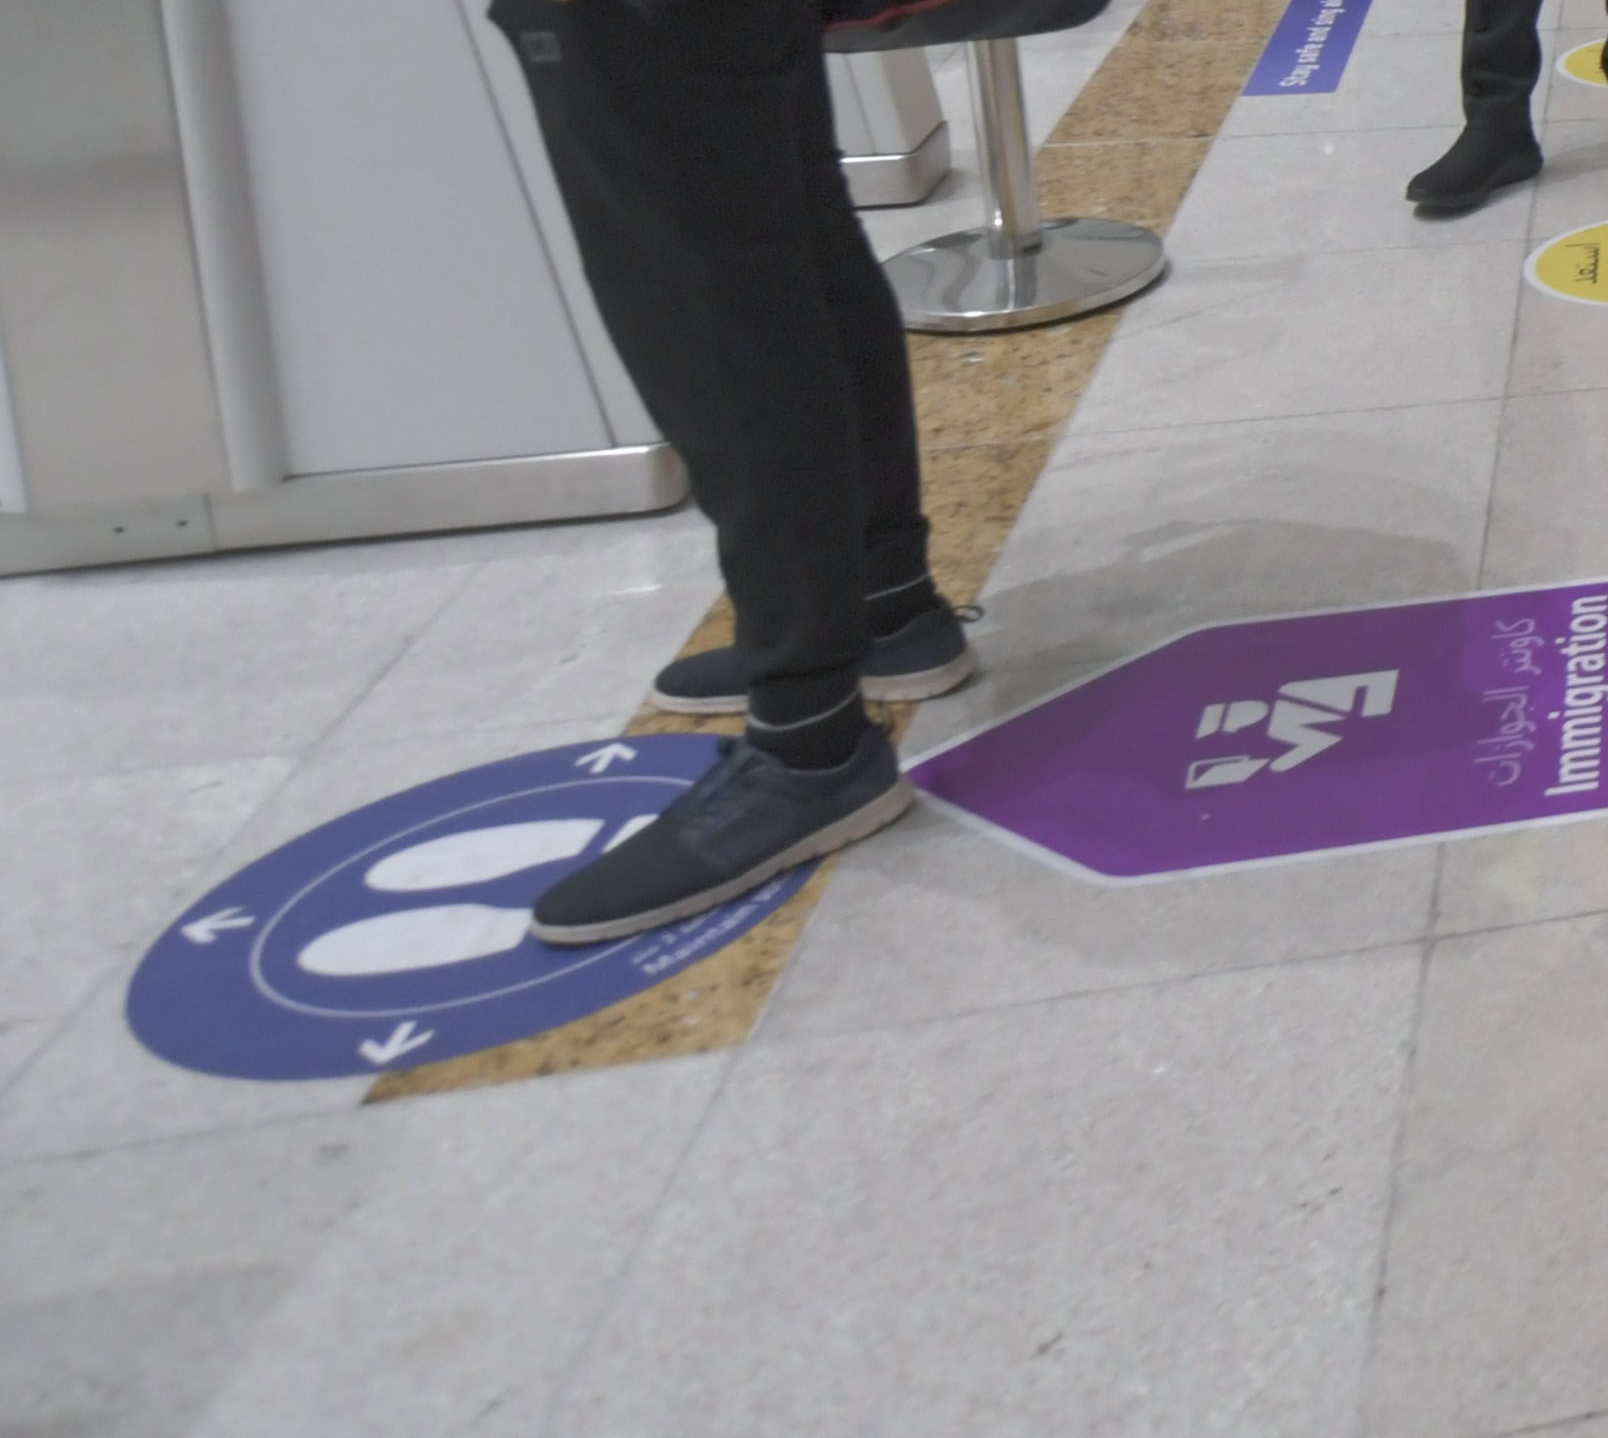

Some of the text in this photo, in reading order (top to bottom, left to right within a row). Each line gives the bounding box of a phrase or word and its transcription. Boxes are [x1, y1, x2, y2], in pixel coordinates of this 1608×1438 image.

[1306, 26, 1331, 42] and
[1296, 43, 1323, 63] safe
[1279, 64, 1320, 87] Stay
